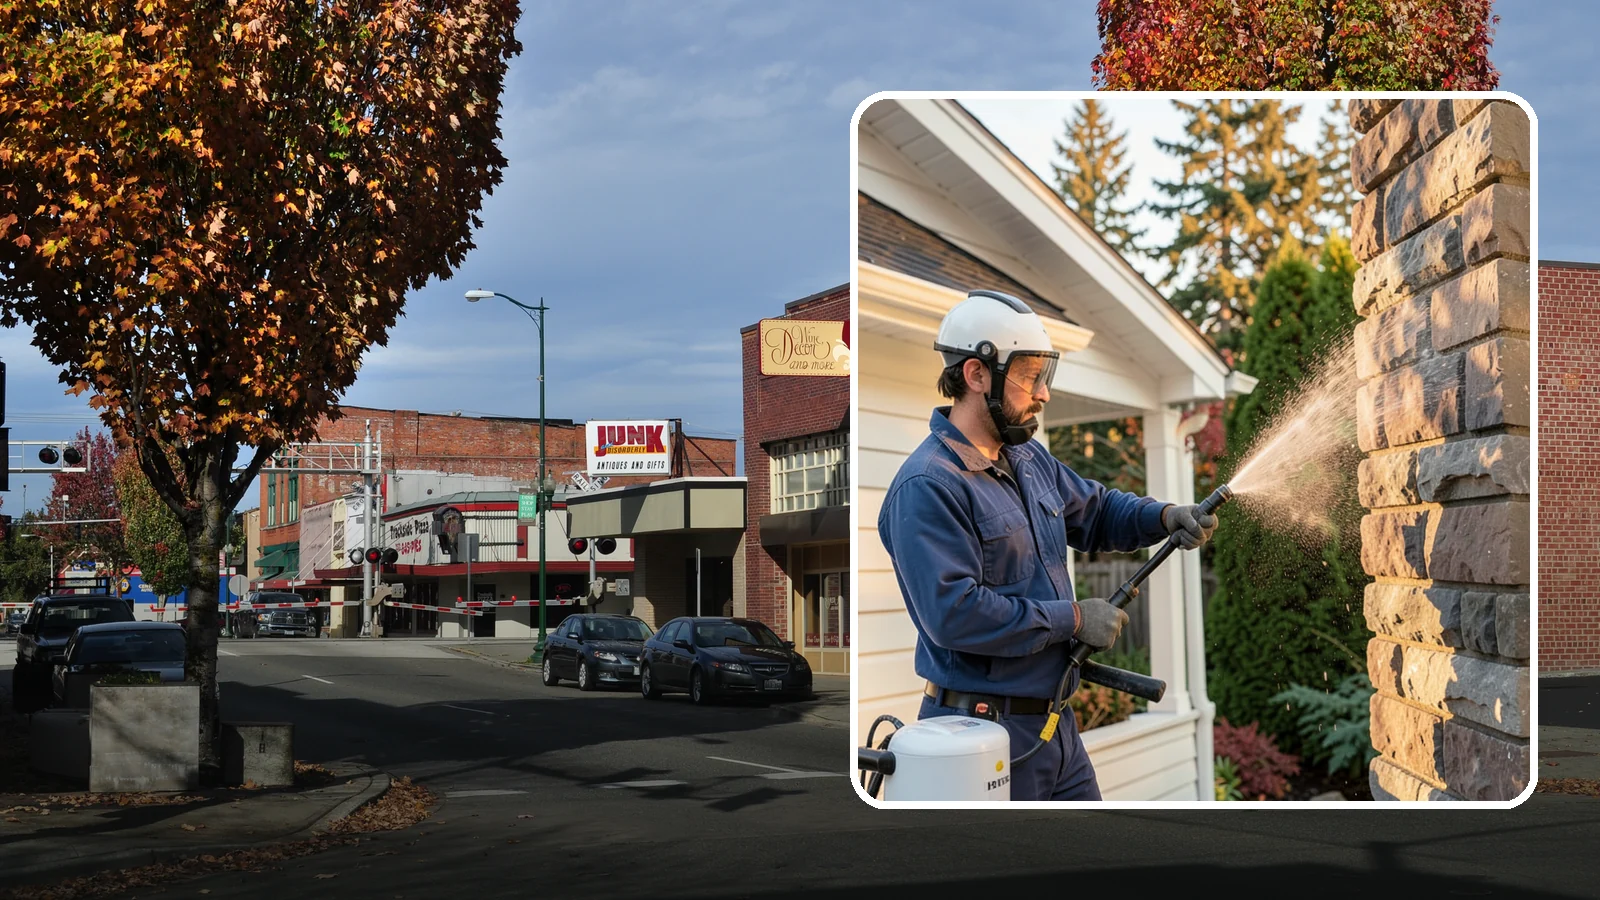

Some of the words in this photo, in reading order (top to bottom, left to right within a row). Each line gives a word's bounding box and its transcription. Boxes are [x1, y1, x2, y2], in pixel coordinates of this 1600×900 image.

[596, 425, 665, 457] JUNK
[607, 446, 646, 454] DISORDERLY
[597, 461, 628, 470] ANTIQUES
[631, 461, 644, 470] AND
[647, 460, 665, 470] GIFTS
[390, 521, 413, 539] Trackside
[414, 519, 429, 535] Pizza
